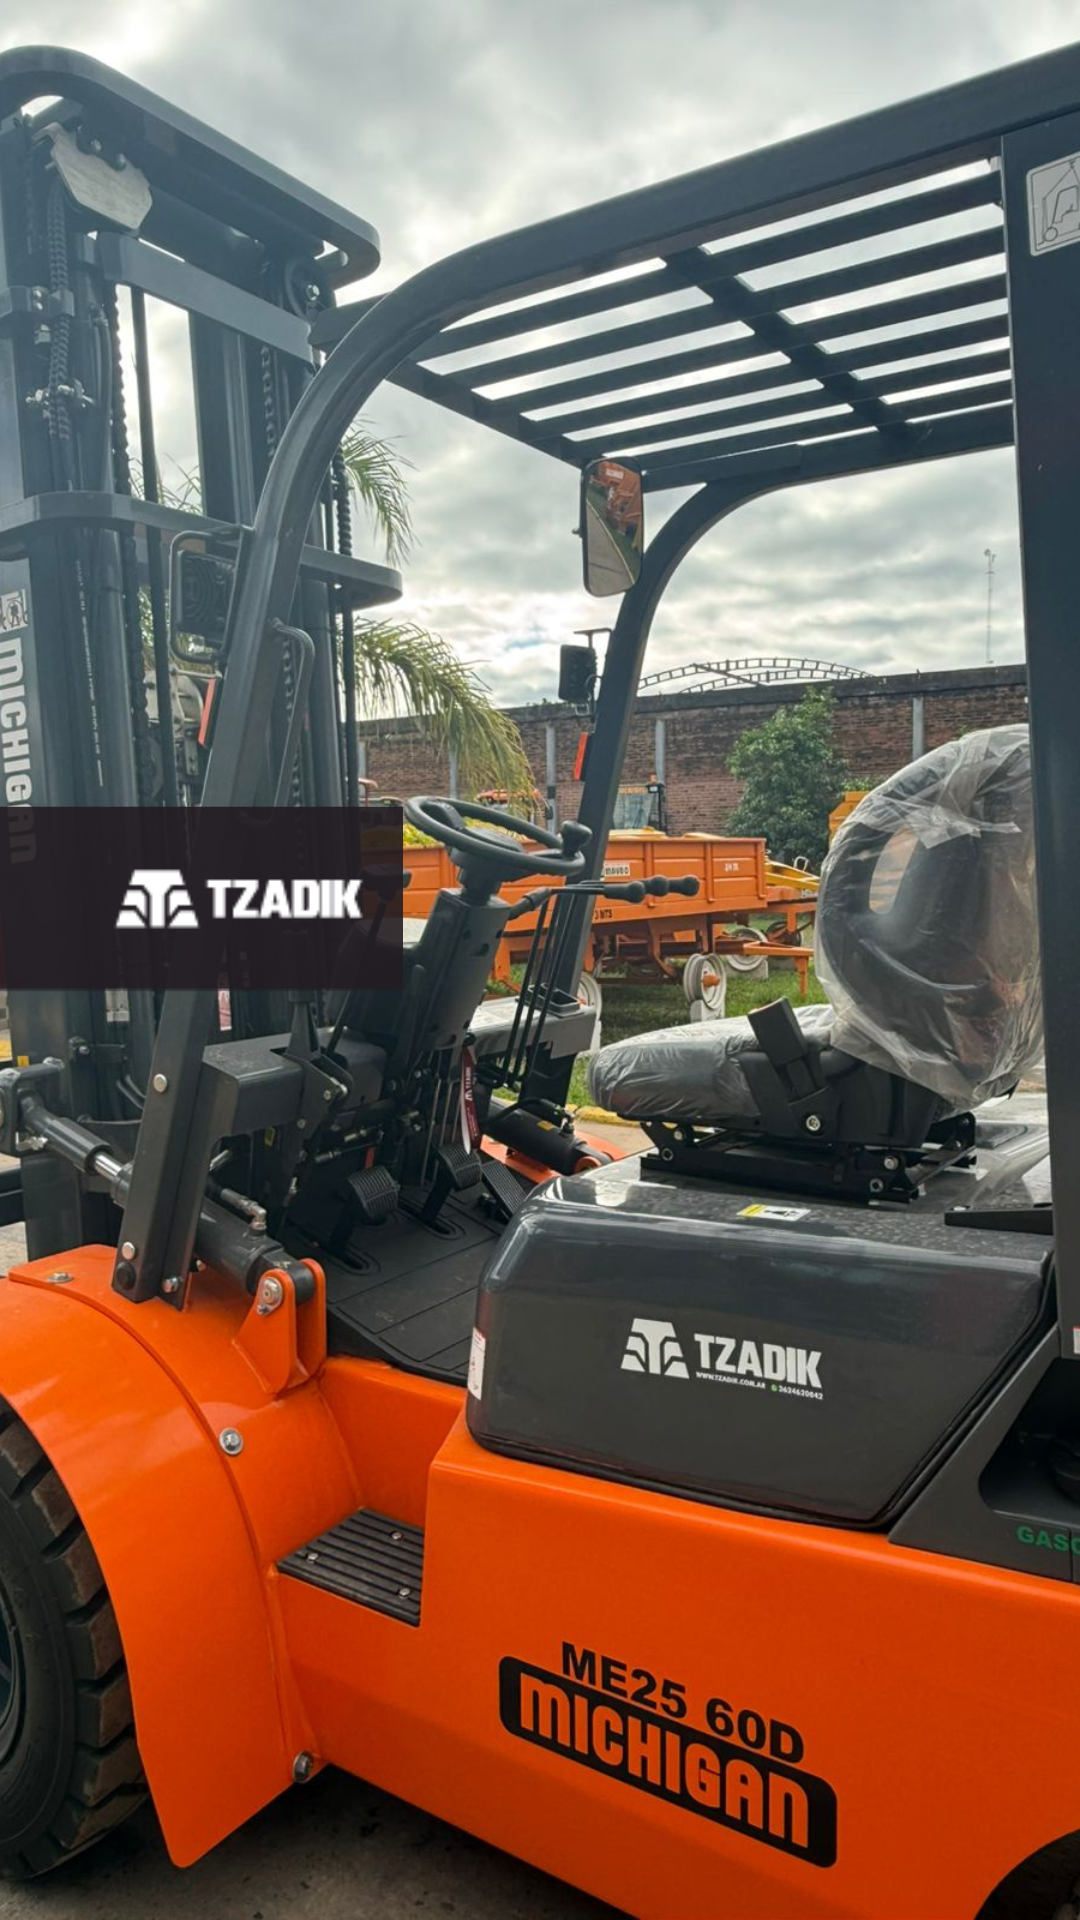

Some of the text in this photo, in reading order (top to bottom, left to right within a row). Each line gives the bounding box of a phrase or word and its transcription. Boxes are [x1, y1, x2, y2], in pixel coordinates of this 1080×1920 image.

[694, 1333, 823, 1389] TZADIK
[696, 1371, 766, 1389] WWW.TZADIK.COM.AR
[561, 1640, 805, 1765] ME25 60D
[519, 1671, 810, 1850] MICHIGAN
